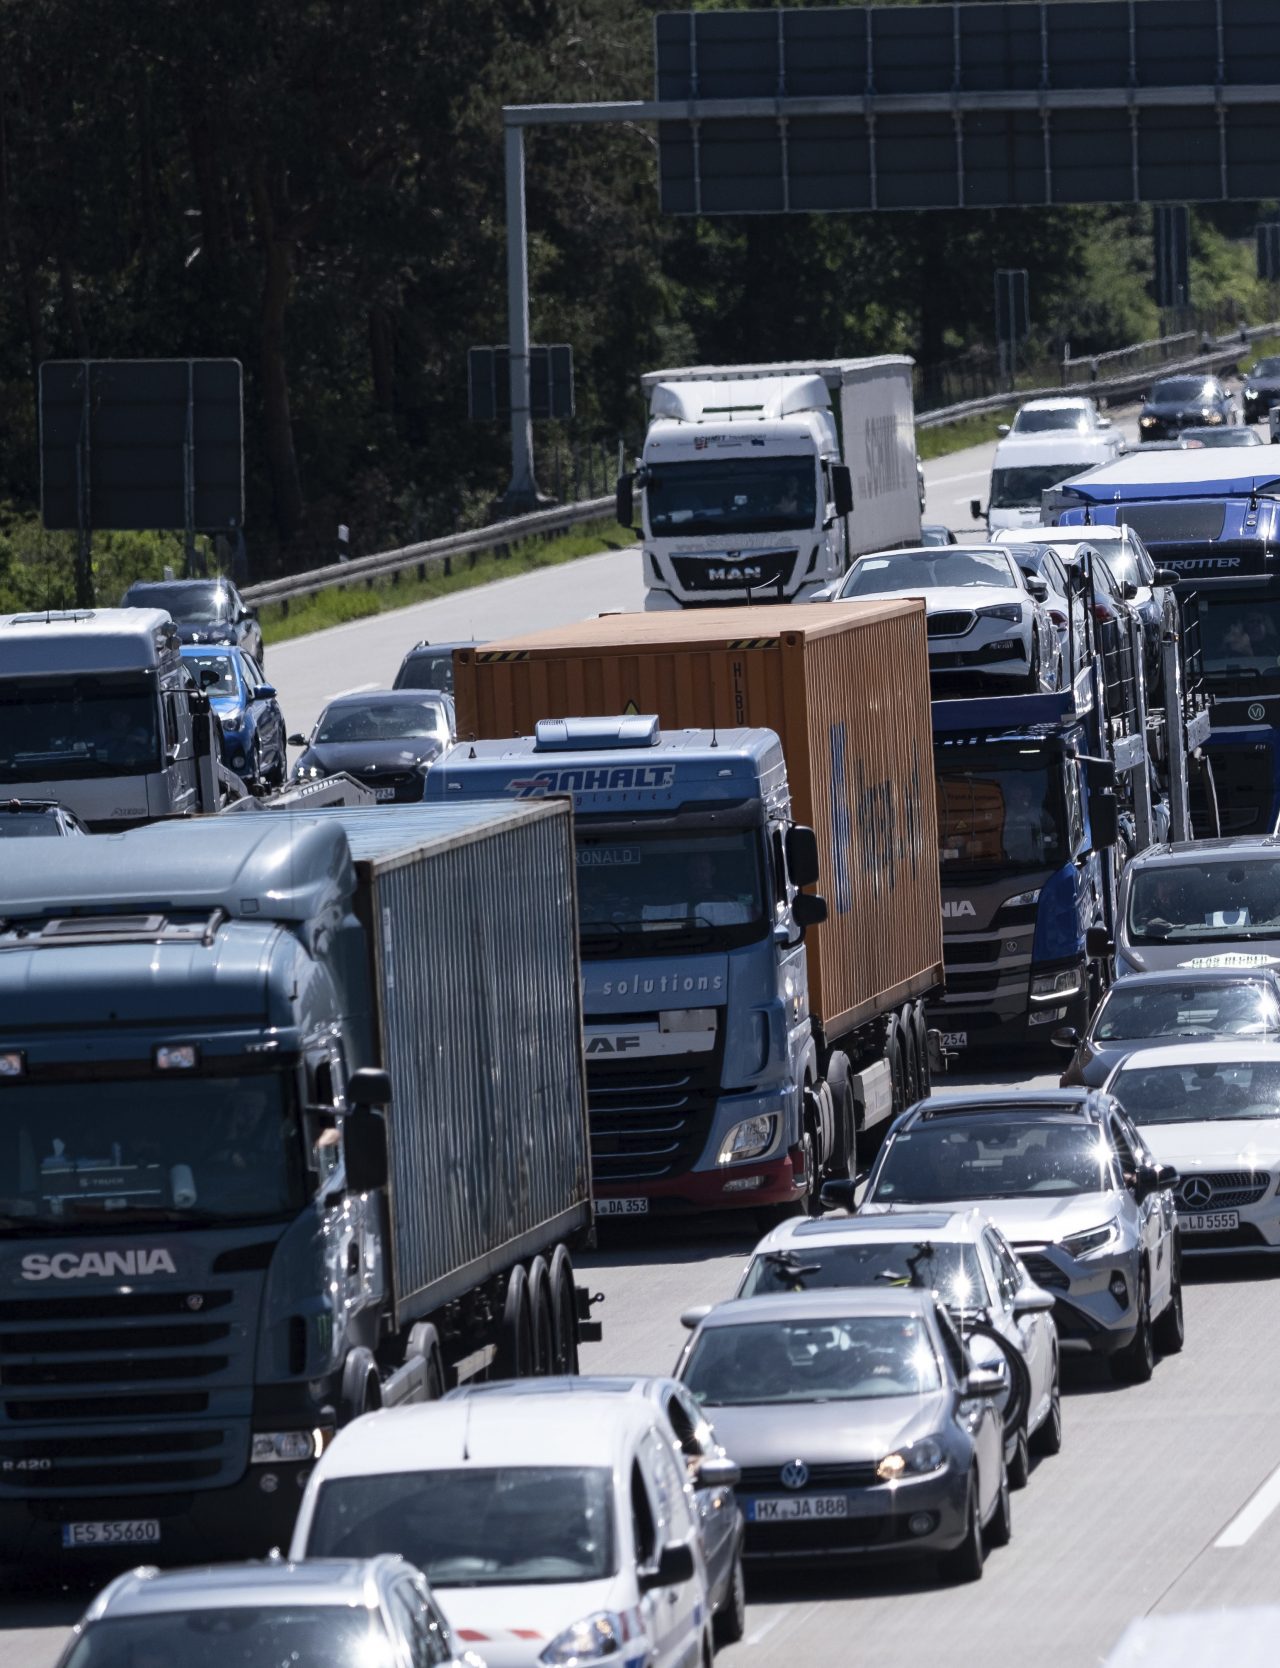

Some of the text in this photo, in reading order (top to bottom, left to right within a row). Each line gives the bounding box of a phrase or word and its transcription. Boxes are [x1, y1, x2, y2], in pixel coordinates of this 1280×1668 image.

[708, 566, 761, 580] MAN
[575, 791, 672, 806] gistics
[603, 973, 723, 996] solutions
[585, 1035, 640, 1054] AF
[608, 1200, 625, 1214] DA
[626, 1199, 648, 1213] 353
[1206, 1213, 1237, 1229] 5555
[21, 1248, 177, 1281] SCANIA
[16, 1458, 52, 1471] 420
[757, 1499, 847, 1520] HX JA 888
[73, 1522, 157, 1543] ES 55660
